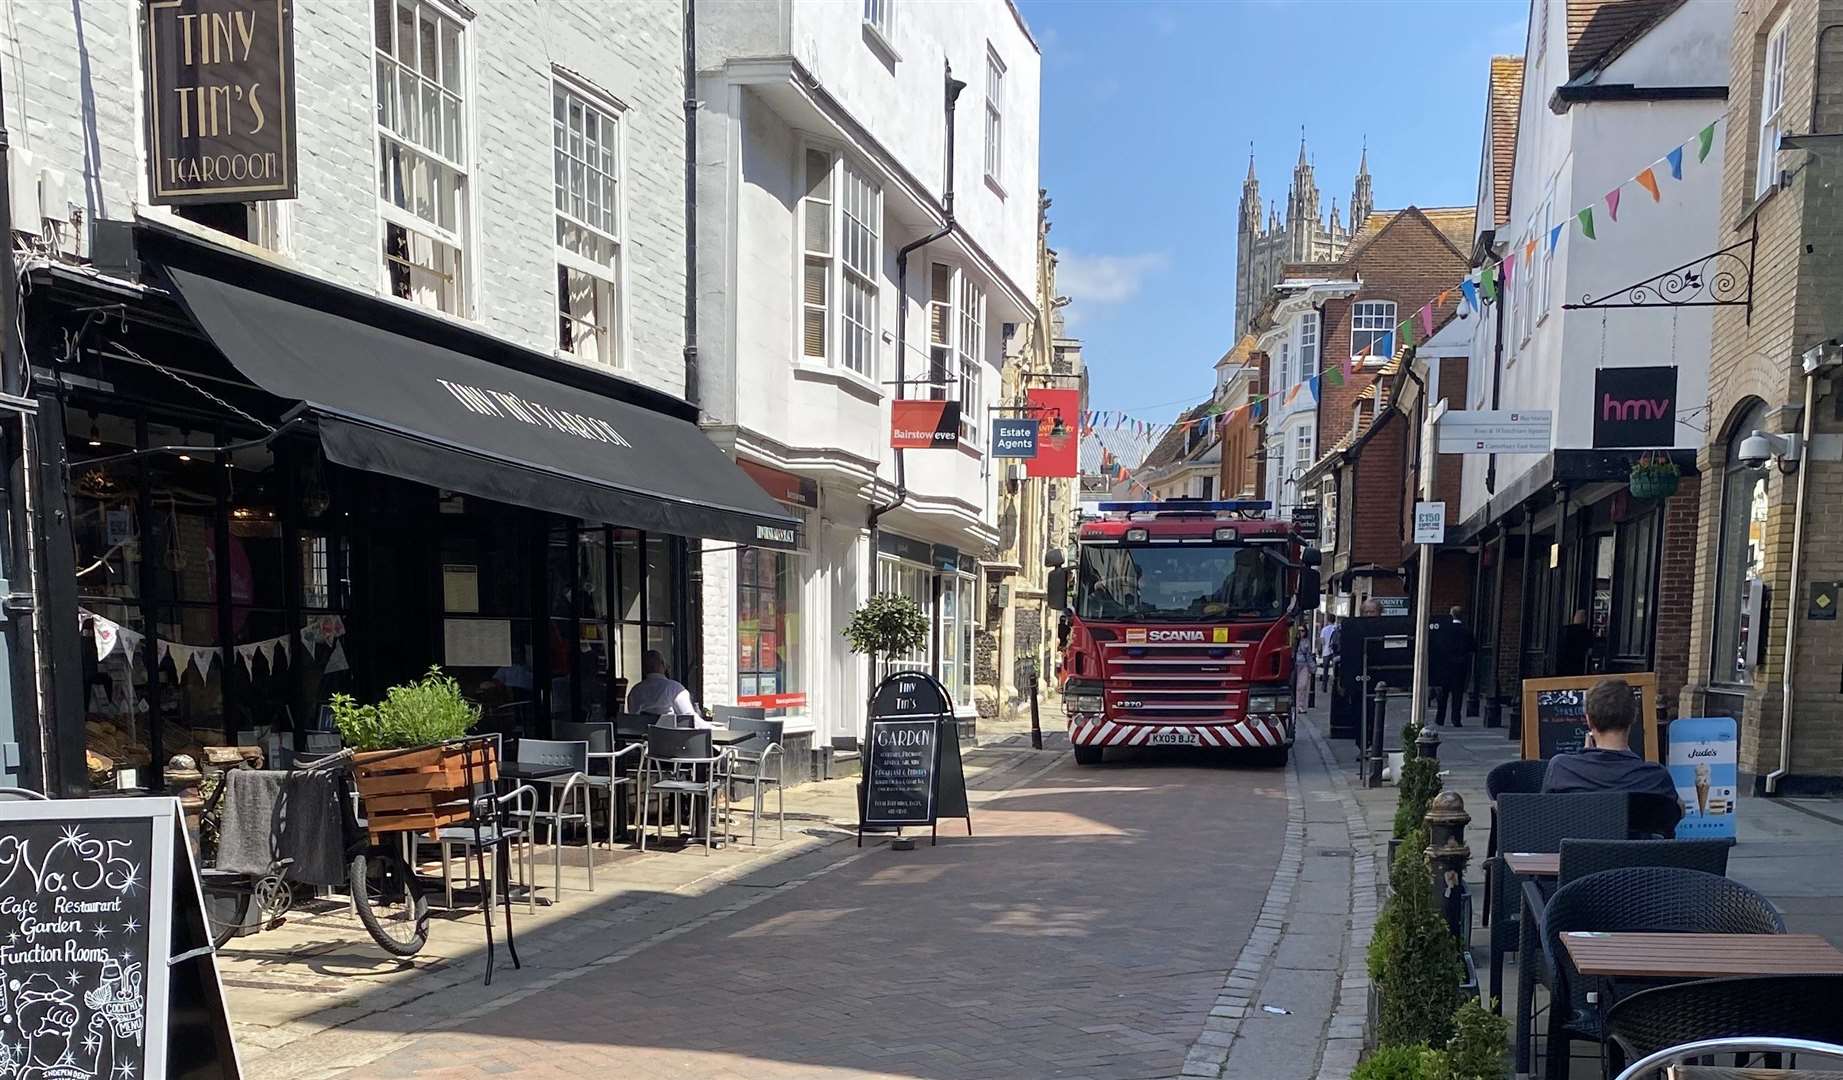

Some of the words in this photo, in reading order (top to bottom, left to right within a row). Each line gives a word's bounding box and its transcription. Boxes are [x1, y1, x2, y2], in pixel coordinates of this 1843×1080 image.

[177, 10, 256, 66] TINY
[174, 83, 265, 138] TIM'S
[436, 378, 505, 418] TINY
[1603, 392, 1669, 421] hmv
[893, 429, 933, 440] Bairstow
[934, 430, 956, 440] eves
[999, 427, 1031, 438] Estate
[998, 439, 1033, 450] Agents
[1418, 512, 1440, 522] £150
[1150, 630, 1205, 641] SCANIA
[878, 730, 930, 747] GARDEN
[1152, 735, 1177, 744] KX09
[1179, 735, 1196, 743] BJZ
[1688, 748, 1718, 759] Jude's
[72, 838, 133, 890] 35
[0, 896, 38, 921] Cafe
[55, 896, 122, 914] Restaurant
[20, 916, 83, 943] Garden
[0, 943, 62, 965] Function
[65, 939, 109, 962] Rooms
[119, 1020, 141, 1036] MENU
